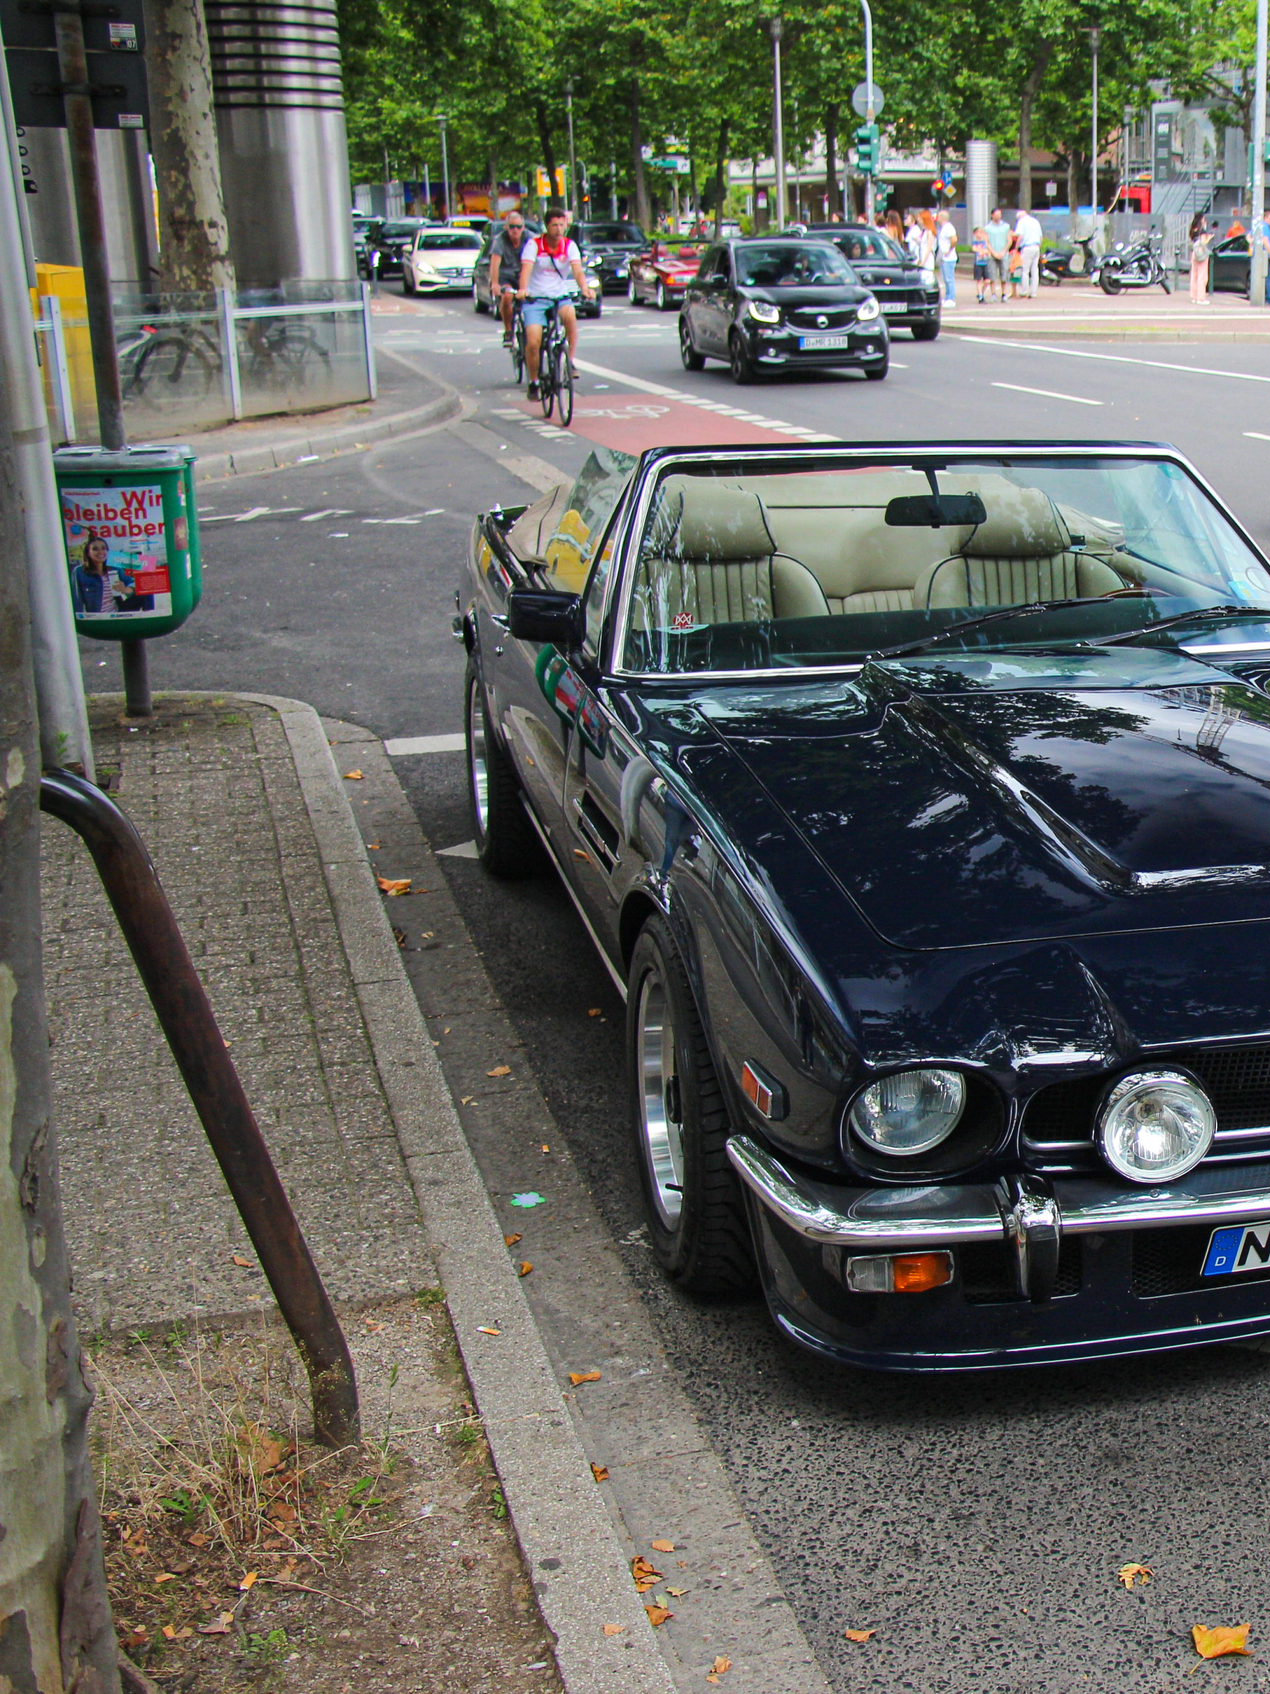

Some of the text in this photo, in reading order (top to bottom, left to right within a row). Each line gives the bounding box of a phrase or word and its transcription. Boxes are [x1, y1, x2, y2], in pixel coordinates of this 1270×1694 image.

[121, 489, 163, 509] Wir
[62, 503, 147, 521] bleiben
[89, 519, 166, 538] sauber
[1214, 1255, 1227, 1267] D
